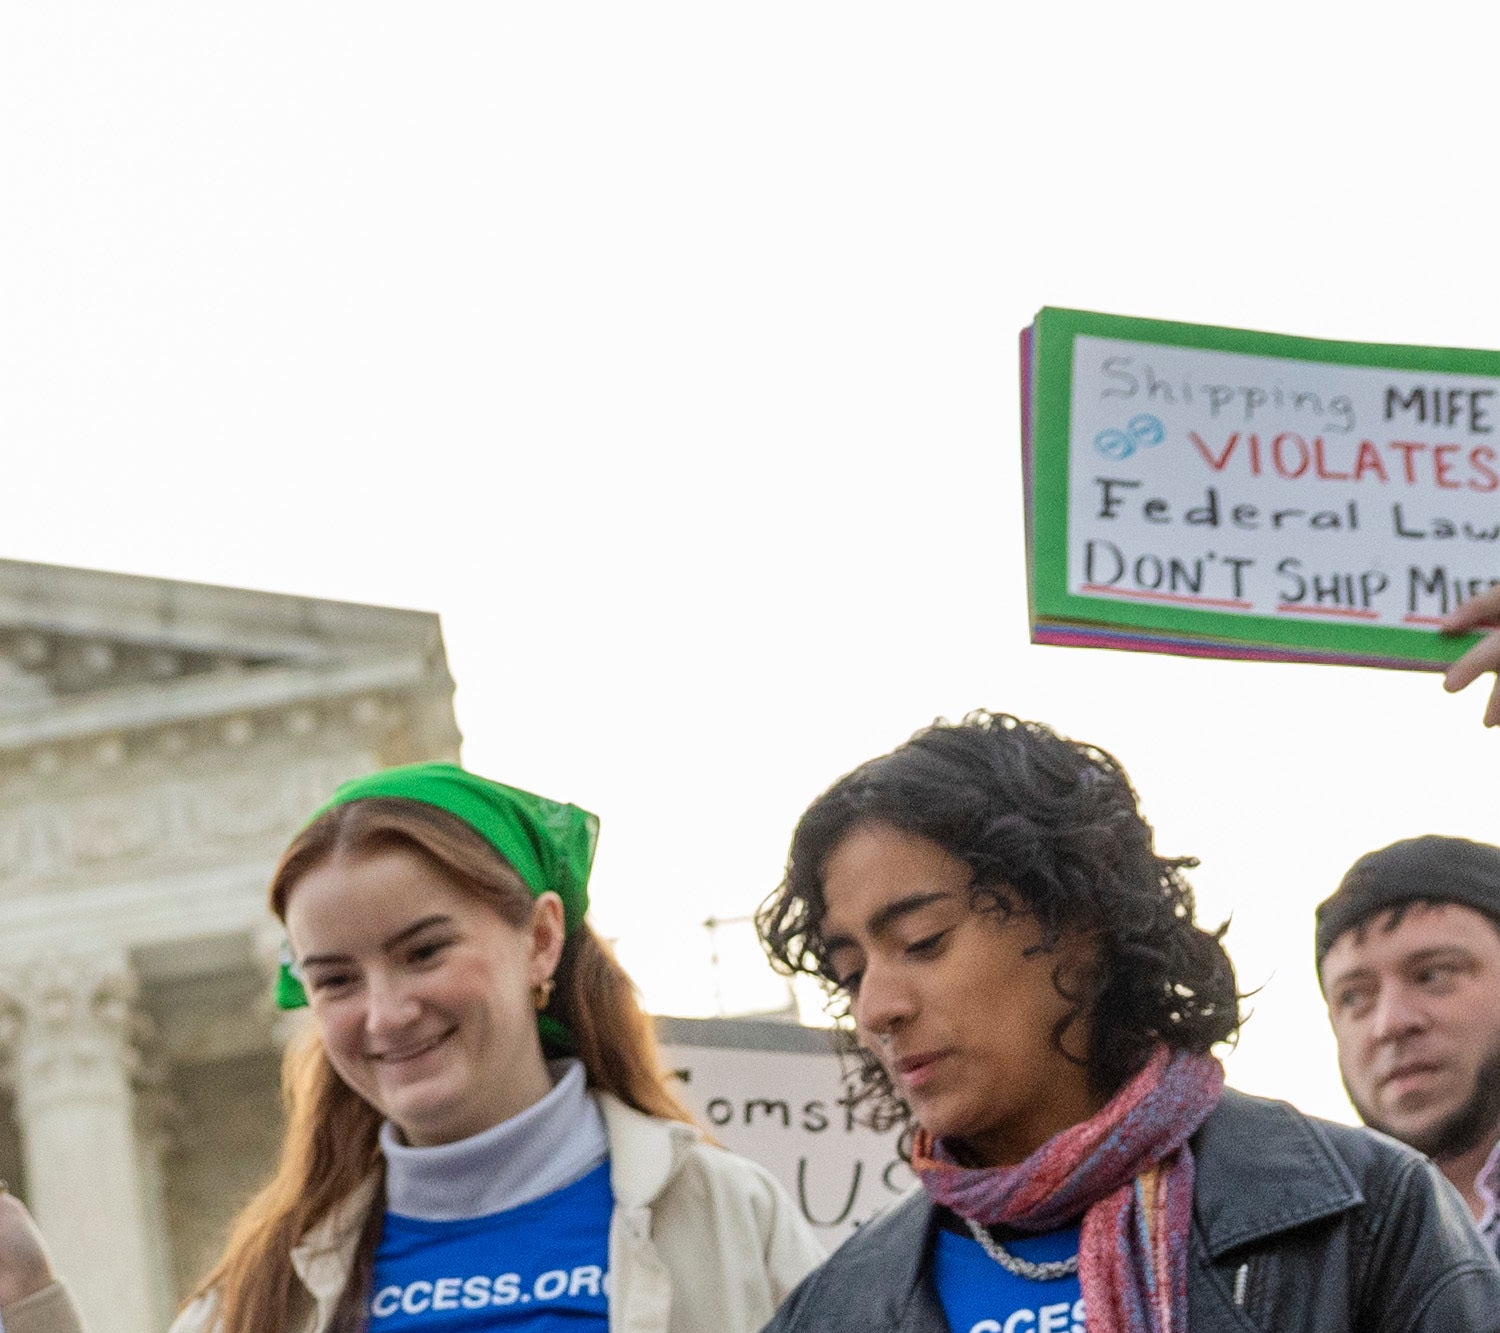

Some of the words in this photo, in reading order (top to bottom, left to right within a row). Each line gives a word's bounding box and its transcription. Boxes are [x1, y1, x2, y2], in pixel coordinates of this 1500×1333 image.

[1100, 355, 1356, 432] Shipping
[1383, 385, 1495, 434] MIFE
[1188, 430, 1500, 492] VIOLATES
[1096, 476, 1360, 531] Federal
[1084, 538, 1254, 600] DON'T
[1275, 558, 1389, 608] SHIP
